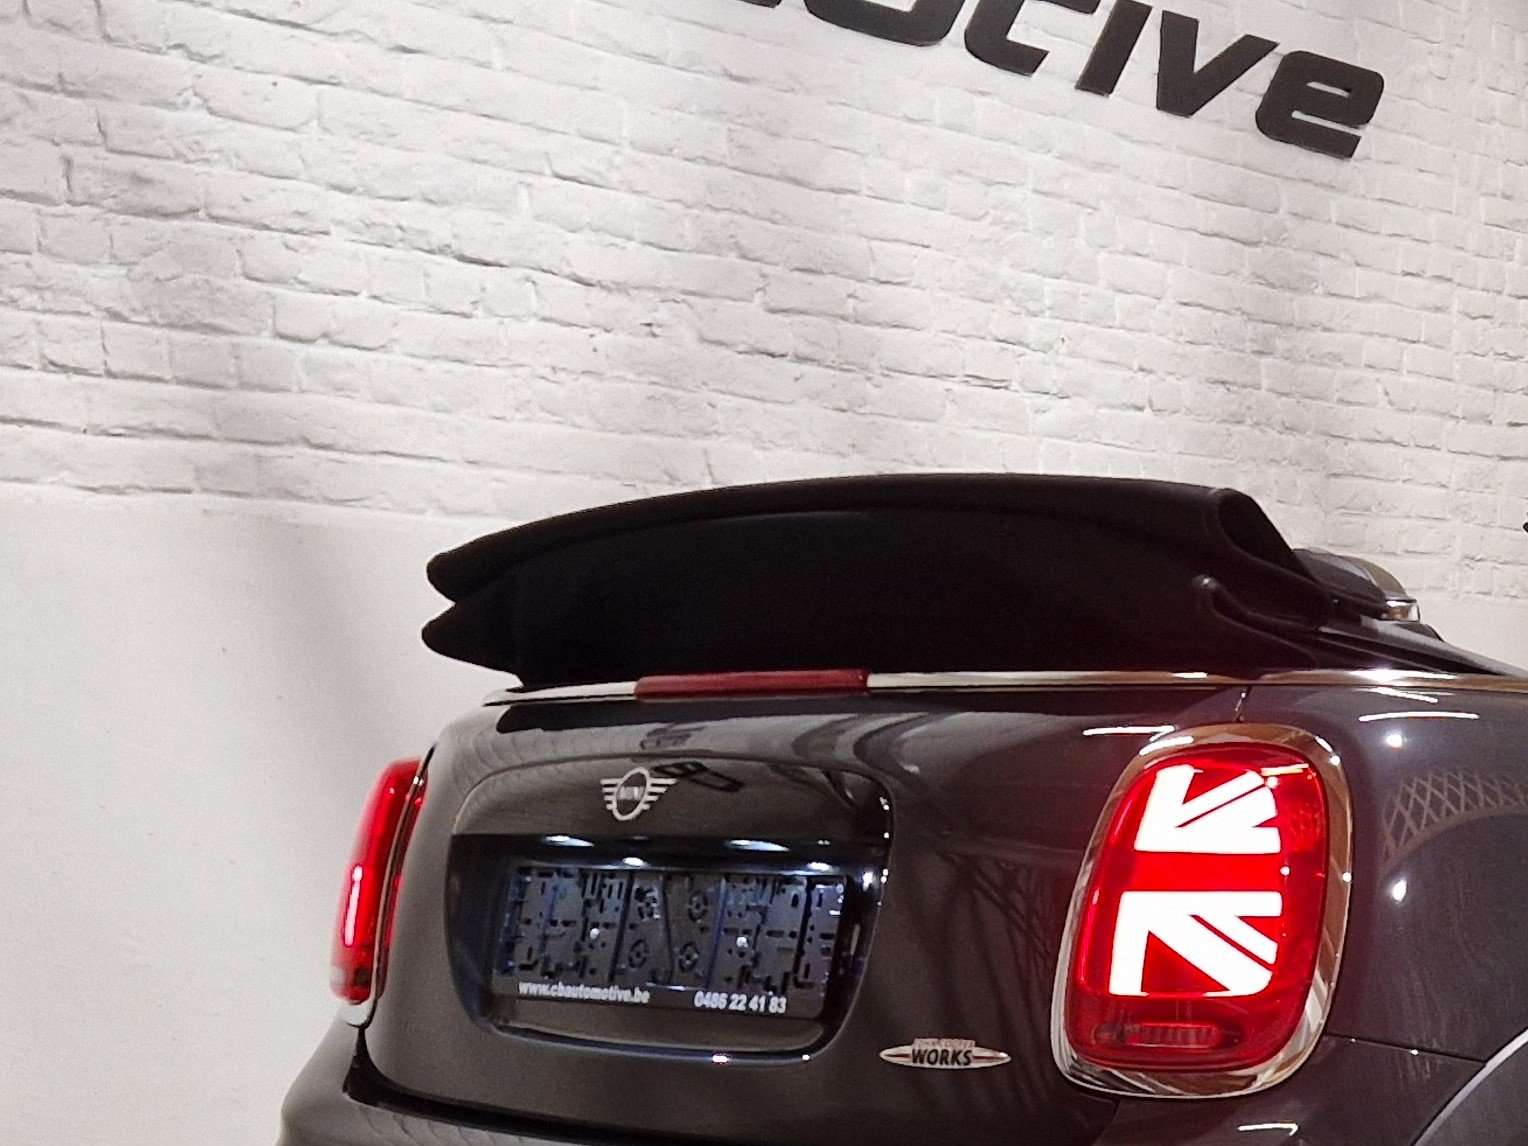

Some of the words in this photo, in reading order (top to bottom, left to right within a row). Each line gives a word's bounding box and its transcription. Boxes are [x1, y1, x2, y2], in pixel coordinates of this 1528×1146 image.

[728, 993, 747, 1011] 22
[748, 994, 766, 1013] 41
[768, 995, 787, 1014] 83
[911, 1048, 972, 1066] WORKS
